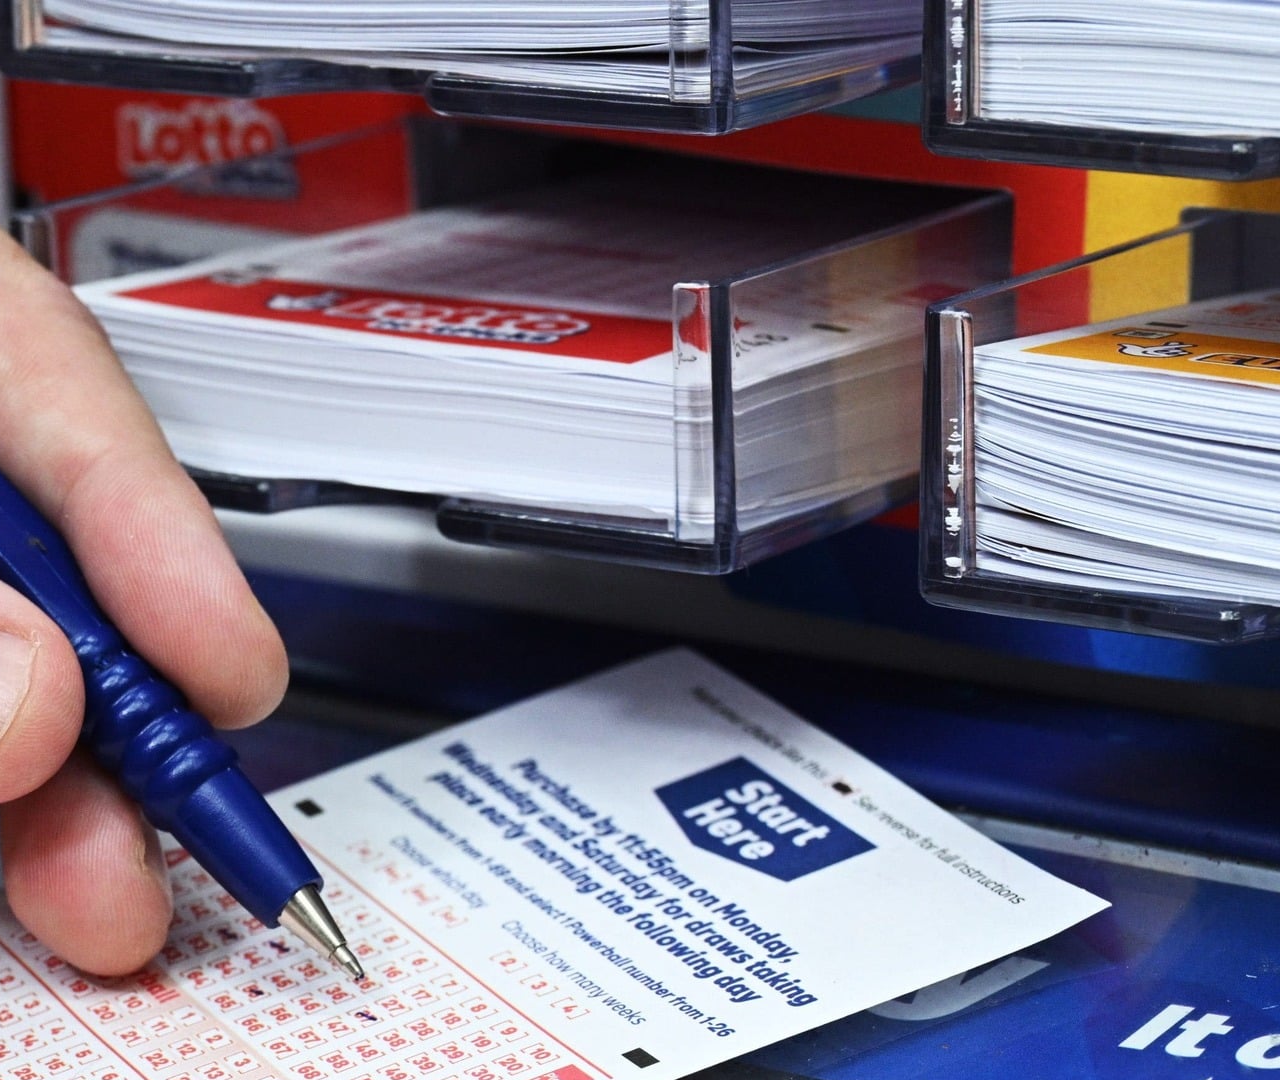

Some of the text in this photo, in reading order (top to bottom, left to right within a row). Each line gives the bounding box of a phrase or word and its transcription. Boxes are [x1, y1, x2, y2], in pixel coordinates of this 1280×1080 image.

[512, 758, 797, 963] Purchase by 11:55pm on Monday,
[684, 799, 773, 859] Here
[726, 781, 828, 845] Start
[427, 771, 761, 1003] place early morning the following day
[538, 815, 583, 841] and
[572, 837, 661, 900] Saturday
[655, 897, 692, 920] for
[684, 920, 752, 963] draws
[745, 960, 817, 1007] taking
[918, 836, 938, 850] for
[933, 847, 960, 864] full
[952, 861, 1025, 904] instructions
[501, 920, 646, 1025] Choose how many weeks
[503, 876, 532, 894] and
[525, 892, 566, 919] select
[565, 921, 632, 967] Powerball
[622, 965, 675, 998] number
[668, 996, 704, 1020] from
[699, 1016, 735, 1037] 1-26
[1119, 1003, 1234, 1057] It
